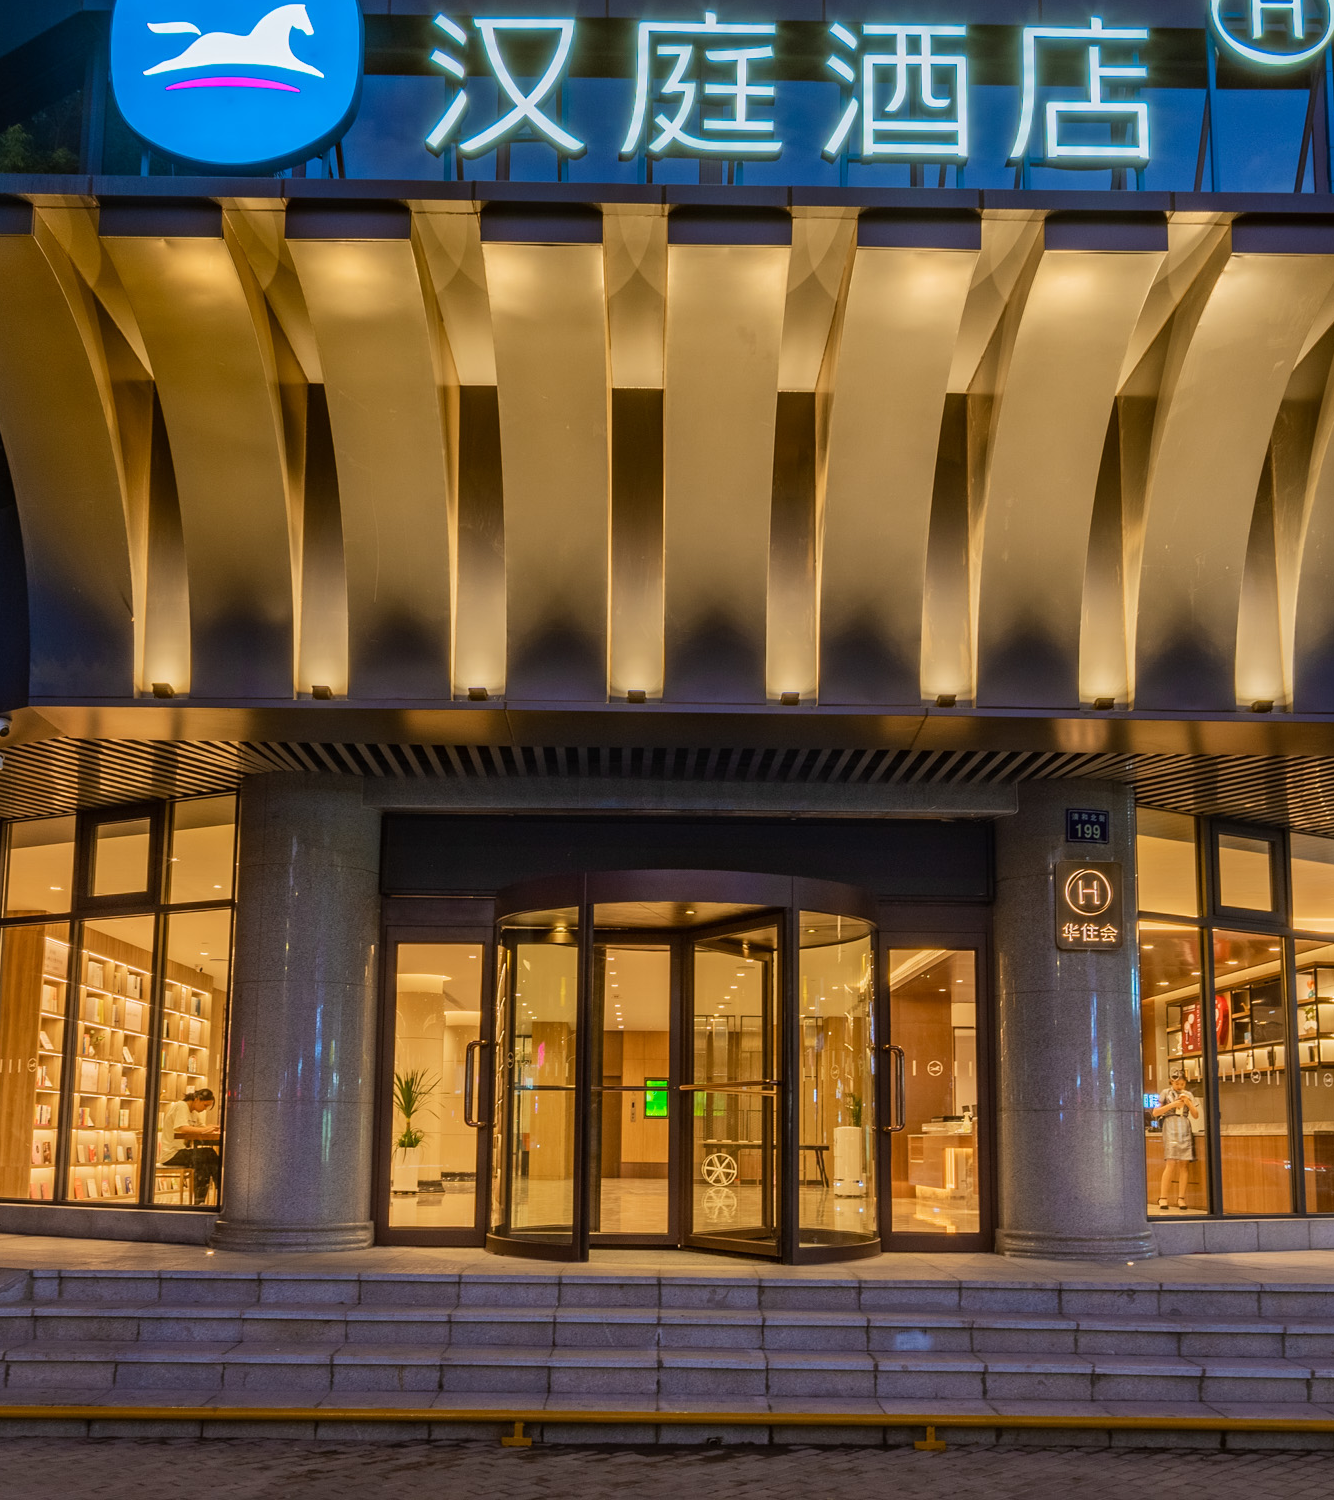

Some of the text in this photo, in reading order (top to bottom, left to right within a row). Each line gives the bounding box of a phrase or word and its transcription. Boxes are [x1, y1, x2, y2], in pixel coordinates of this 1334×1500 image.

[425, 11, 1151, 162] 汉庭酒店
[1075, 823, 1101, 839] 199
[1078, 880, 1101, 905] H
[1062, 923, 1118, 943] 华住会
